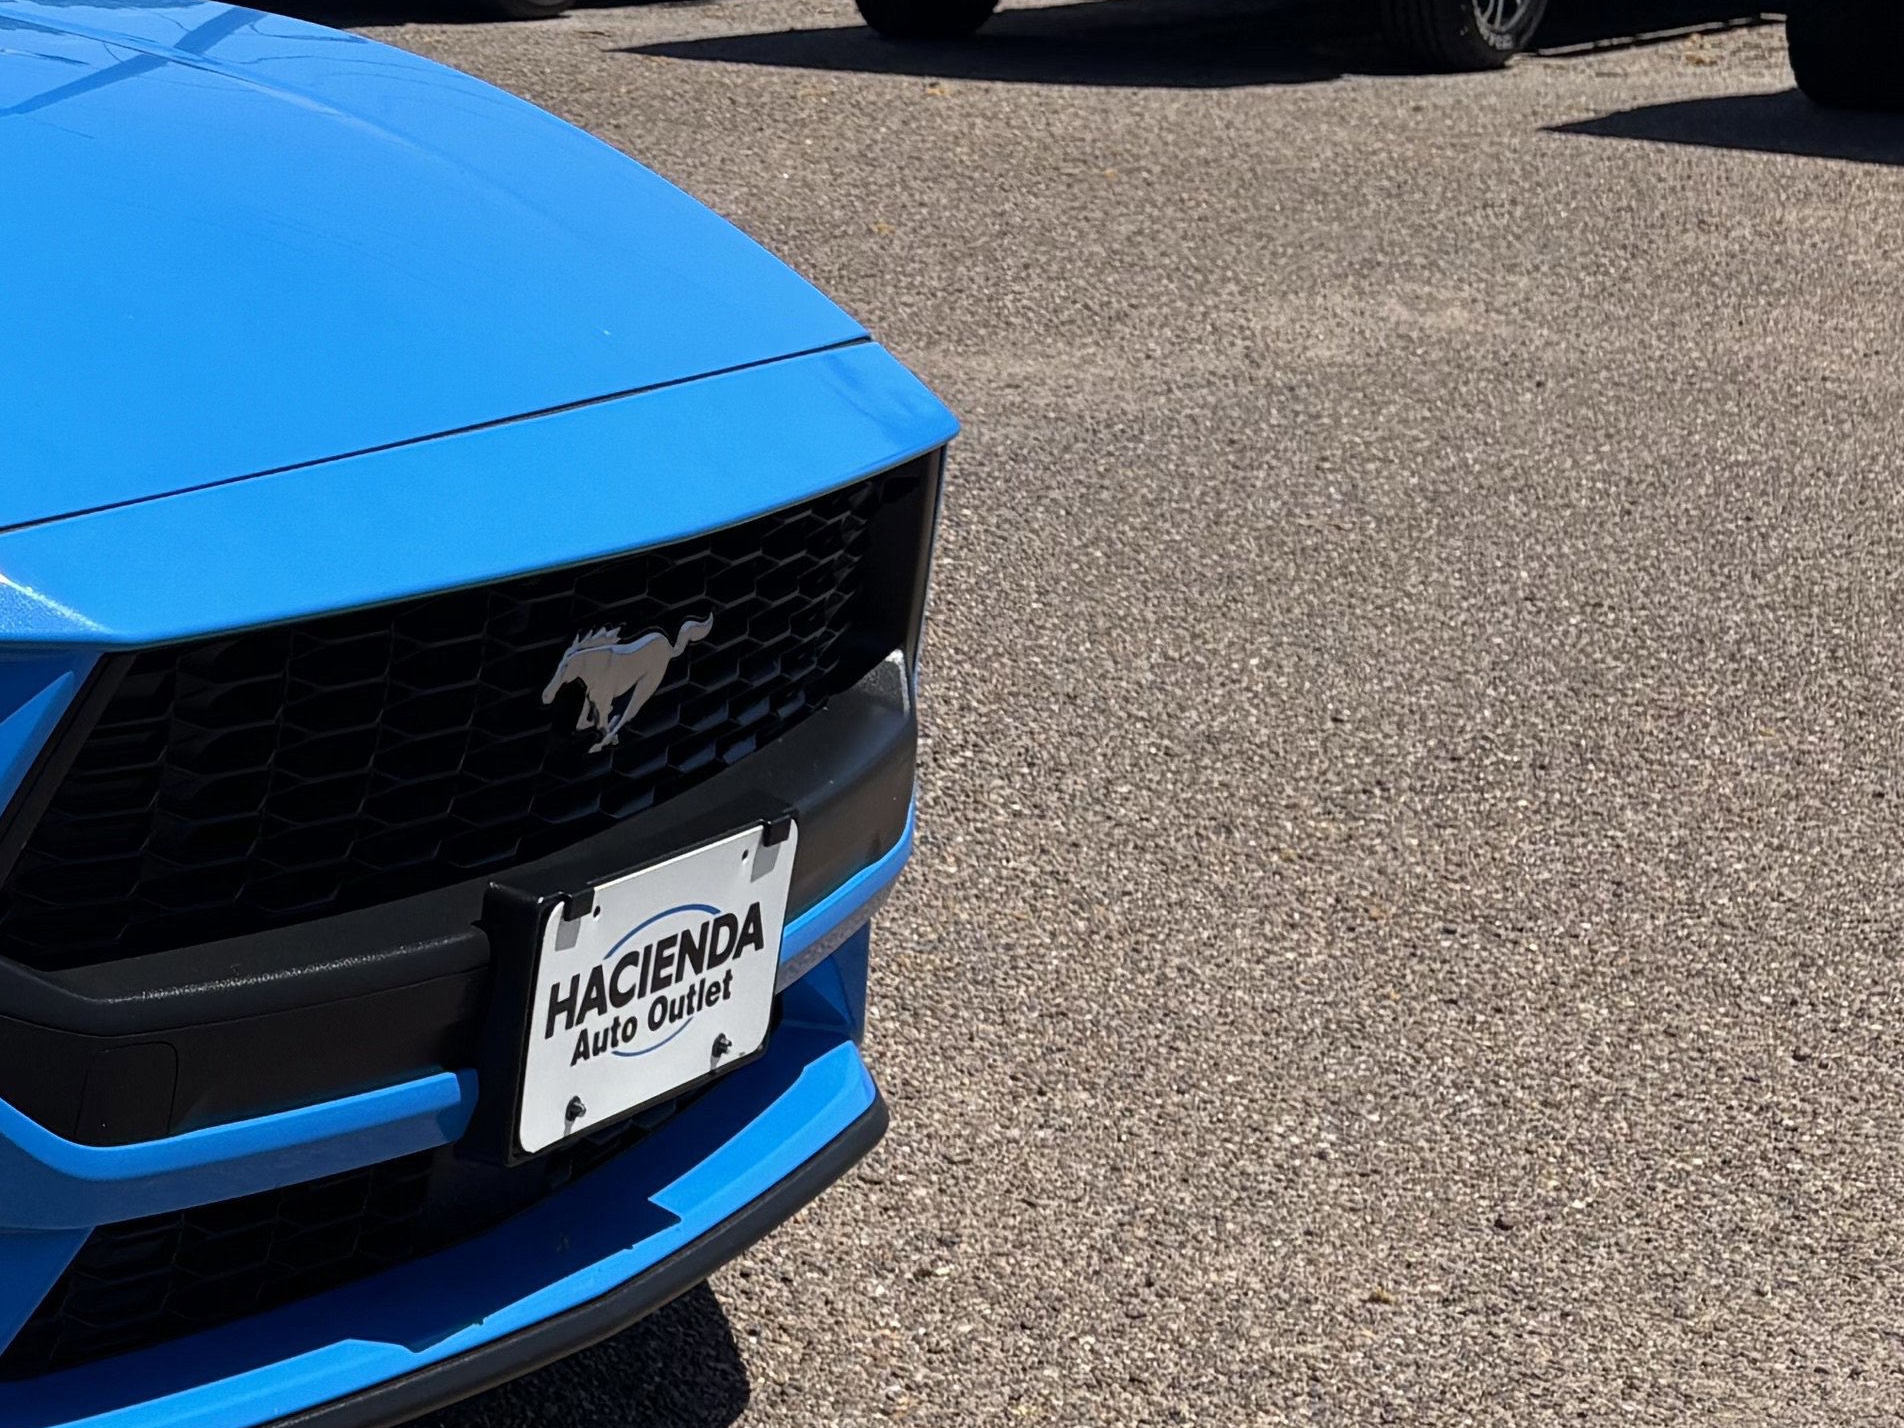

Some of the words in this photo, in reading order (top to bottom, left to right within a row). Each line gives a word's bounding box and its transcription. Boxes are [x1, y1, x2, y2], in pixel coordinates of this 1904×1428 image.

[544, 901, 765, 1040] HACIENDA
[571, 1012, 637, 1067] Auto
[647, 968, 733, 1032] Outlet
